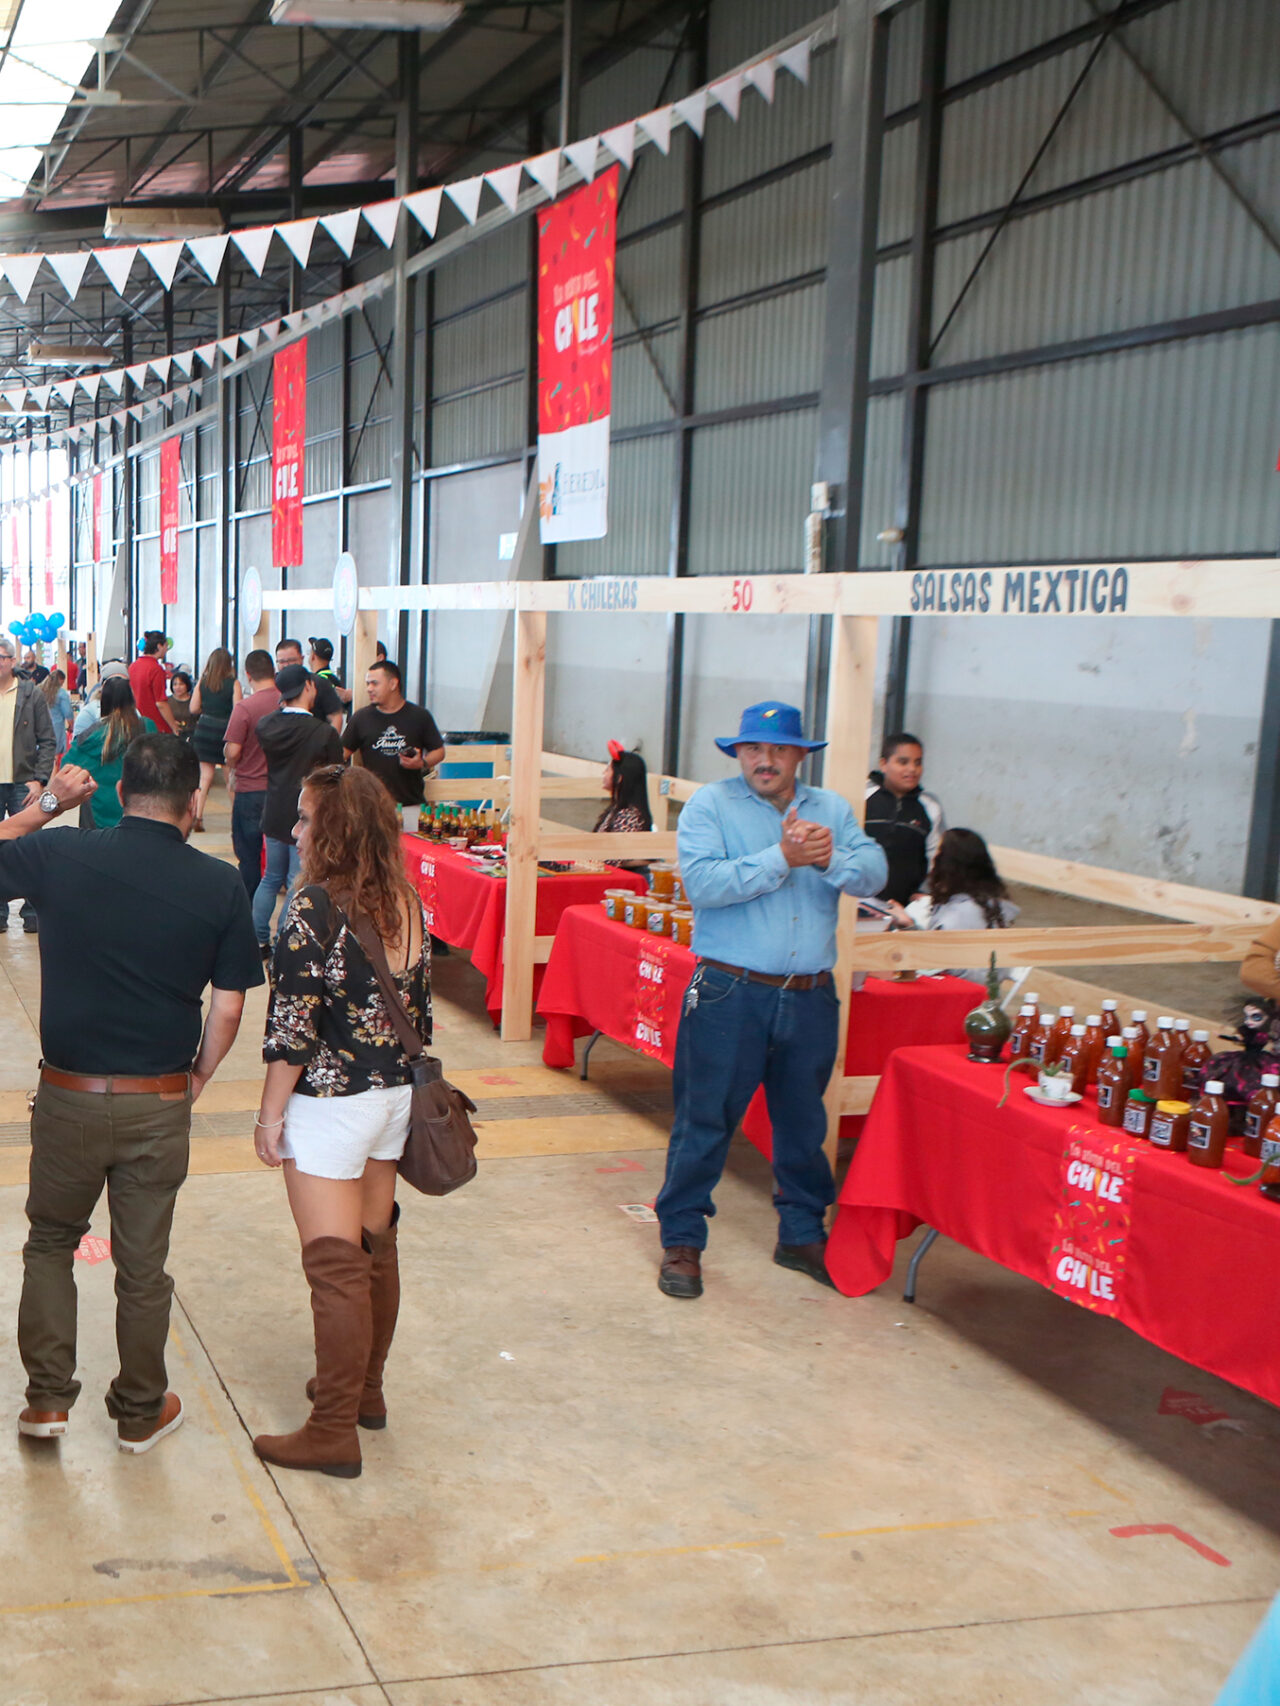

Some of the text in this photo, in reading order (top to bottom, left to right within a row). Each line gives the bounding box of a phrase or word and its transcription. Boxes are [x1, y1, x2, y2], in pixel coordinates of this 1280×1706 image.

[567, 580, 638, 609] K CHILERAS
[732, 579, 754, 612] 50
[910, 567, 1128, 613] SALSAS MEXTICA
[1067, 1160, 1125, 1203] CHILE
[1055, 1256, 1116, 1301] CHILE
